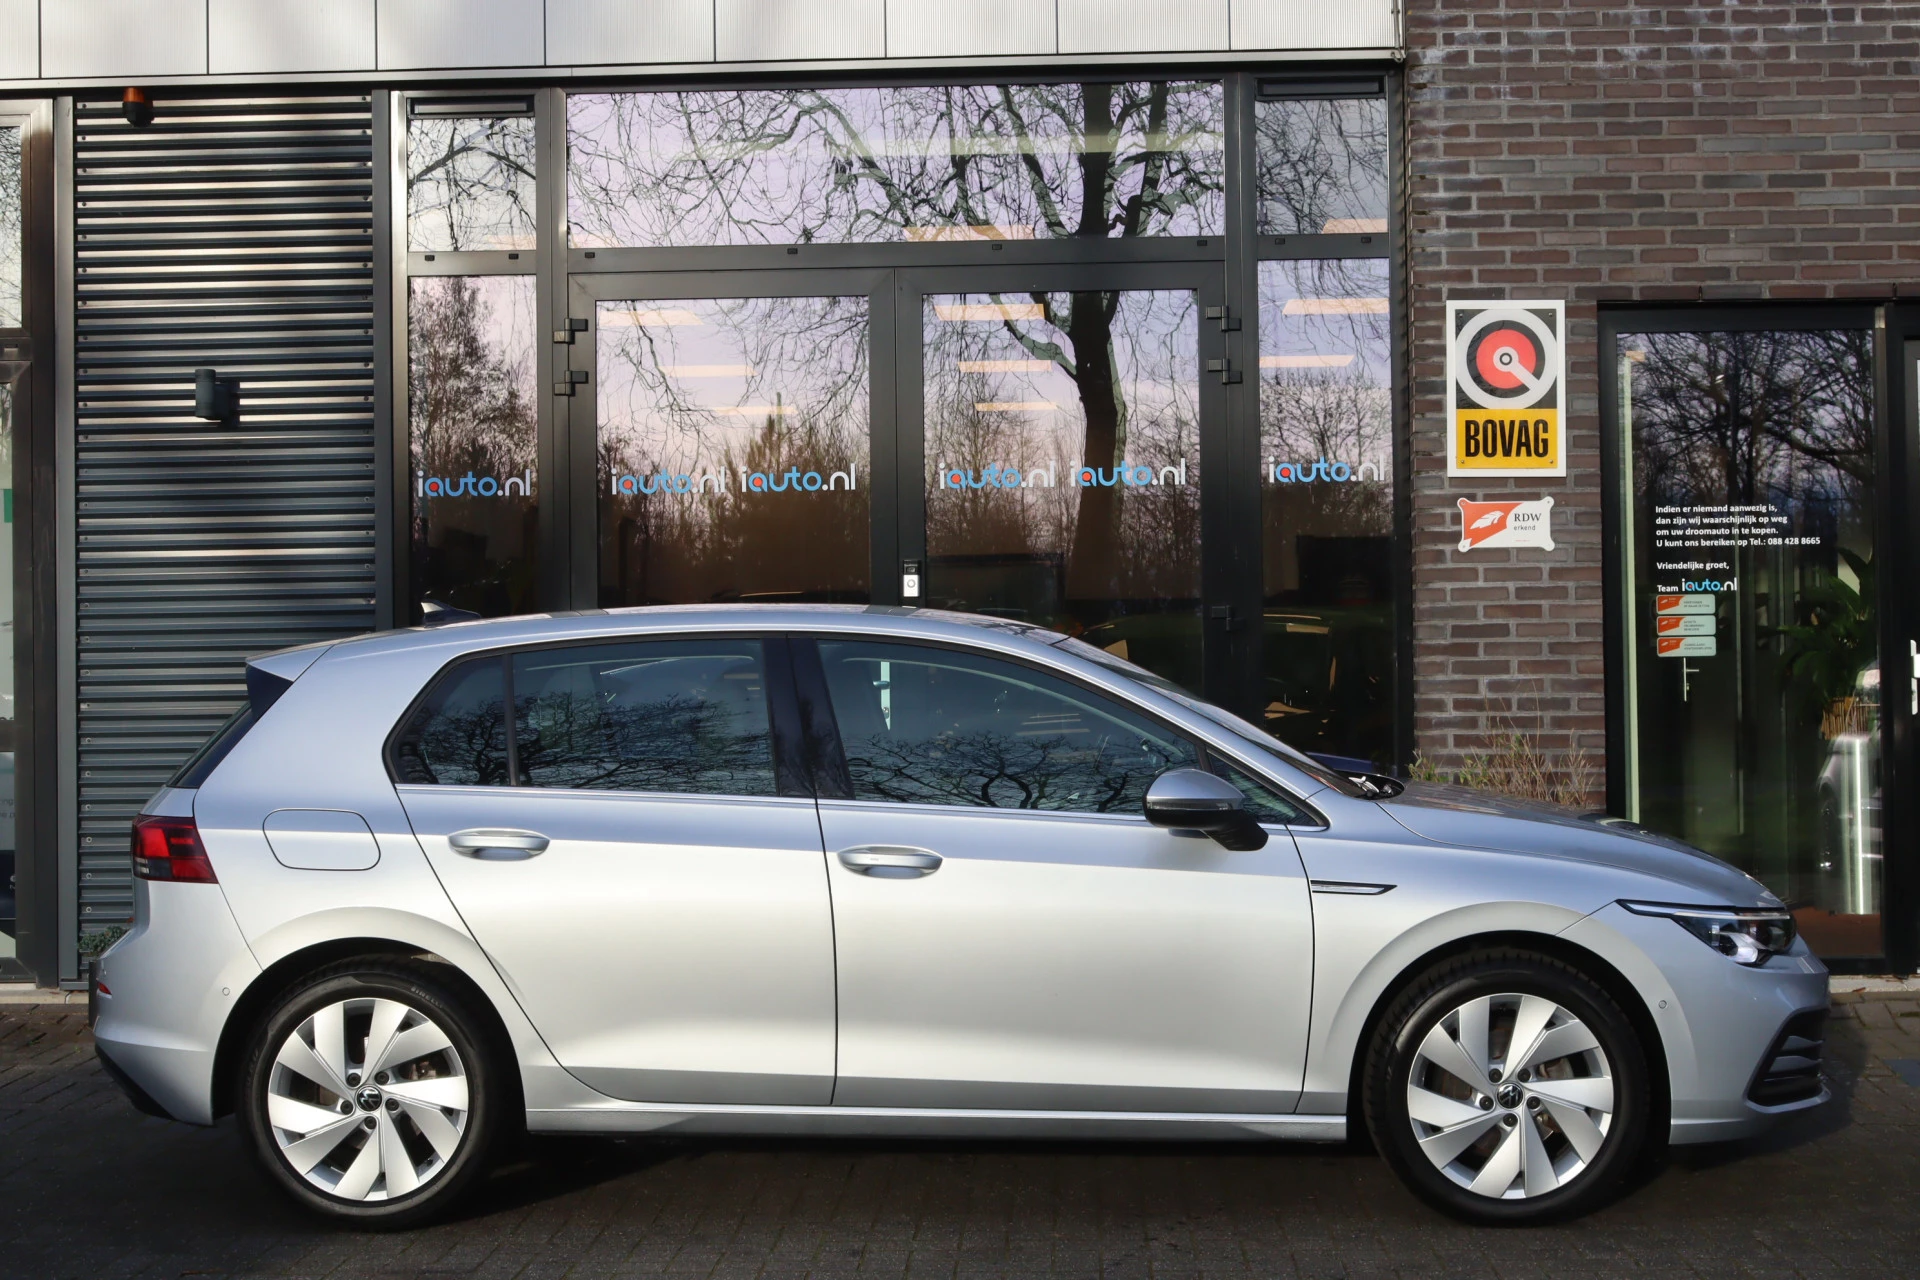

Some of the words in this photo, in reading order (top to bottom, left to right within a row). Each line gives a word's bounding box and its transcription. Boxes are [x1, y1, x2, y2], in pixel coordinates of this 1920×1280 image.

[1464, 419, 1549, 458] BOVAG
[741, 463, 856, 493] iauto.nl
[939, 460, 1055, 490] iauto.nl
[1069, 458, 1186, 487] iauto.nl
[1268, 455, 1385, 484] iauto.nl
[417, 469, 531, 497] iauto.nl
[611, 466, 725, 496] iauto.nl
[1514, 513, 1542, 522] RDW
[1655, 505, 1680, 514] Indien
[1693, 504, 1728, 513] niemand
[1729, 503, 1767, 513] aanwezig
[1768, 503, 1778, 513] is,
[1655, 516, 1671, 525] dan
[1672, 516, 1687, 526] zijn
[1688, 516, 1701, 526] wij
[1702, 515, 1757, 525] waarschijnlijk
[1758, 516, 1769, 524] op
[1770, 516, 1788, 524] weg
[1685, 527, 1731, 536] droomauto
[1731, 526, 1740, 535] in
[1741, 527, 1750, 535] te
[1751, 526, 1779, 536] kopen.
[1656, 539, 1663, 547] U
[1664, 539, 1683, 547] kunt
[1700, 538, 1736, 547] bereiken
[1737, 539, 1748, 548] op
[1749, 538, 1766, 546] Tel.:
[1767, 537, 1783, 546] 088
[1784, 537, 1800, 546] 428
[1800, 536, 1821, 546] 8665
[1656, 561, 1705, 571] Vriendelijke
[1705, 561, 1730, 571] groet,
[1657, 584, 1679, 593] Team
[1681, 577, 1738, 592] iauto.nl
